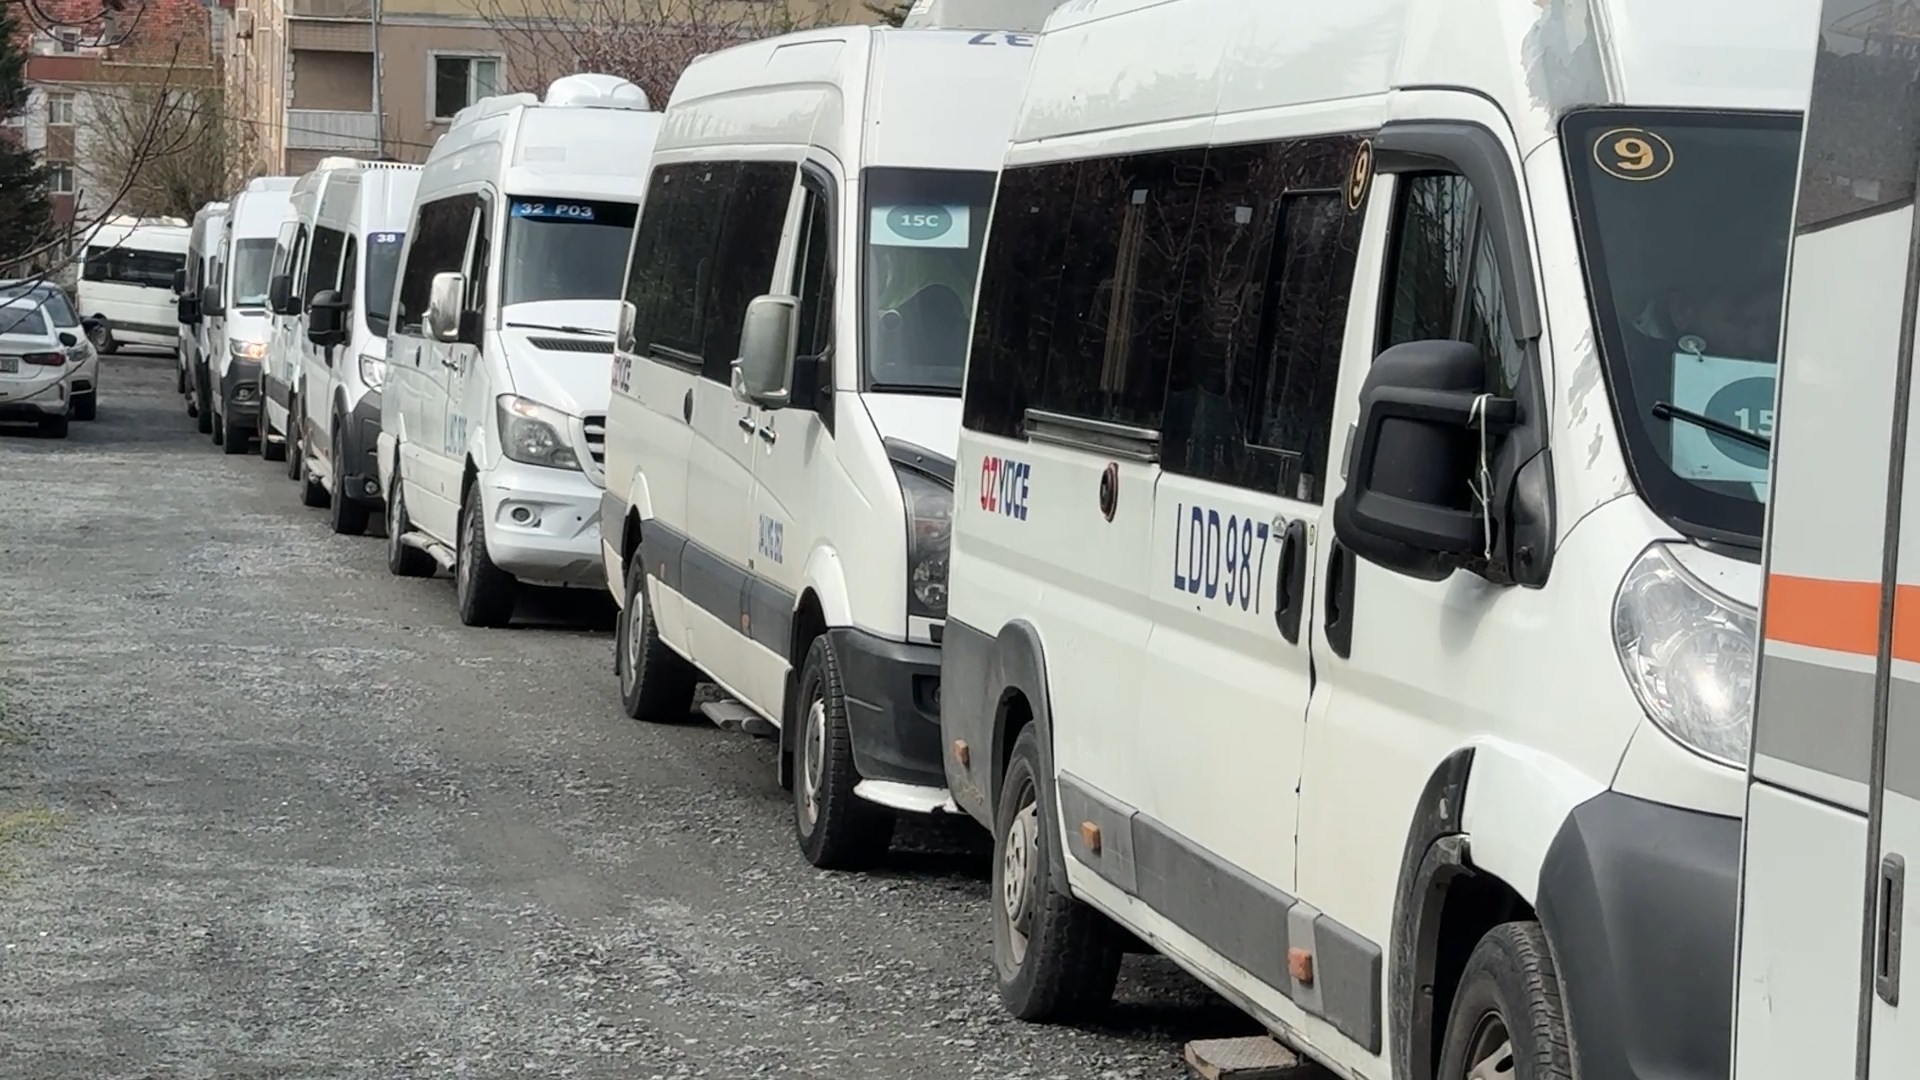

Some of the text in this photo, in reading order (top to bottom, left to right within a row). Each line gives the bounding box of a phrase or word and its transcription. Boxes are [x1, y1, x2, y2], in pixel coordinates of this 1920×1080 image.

[1614, 138, 1654, 170] 9
[1353, 151, 1368, 197] 9
[520, 203, 544, 214] 32
[901, 214, 939, 227] 15C
